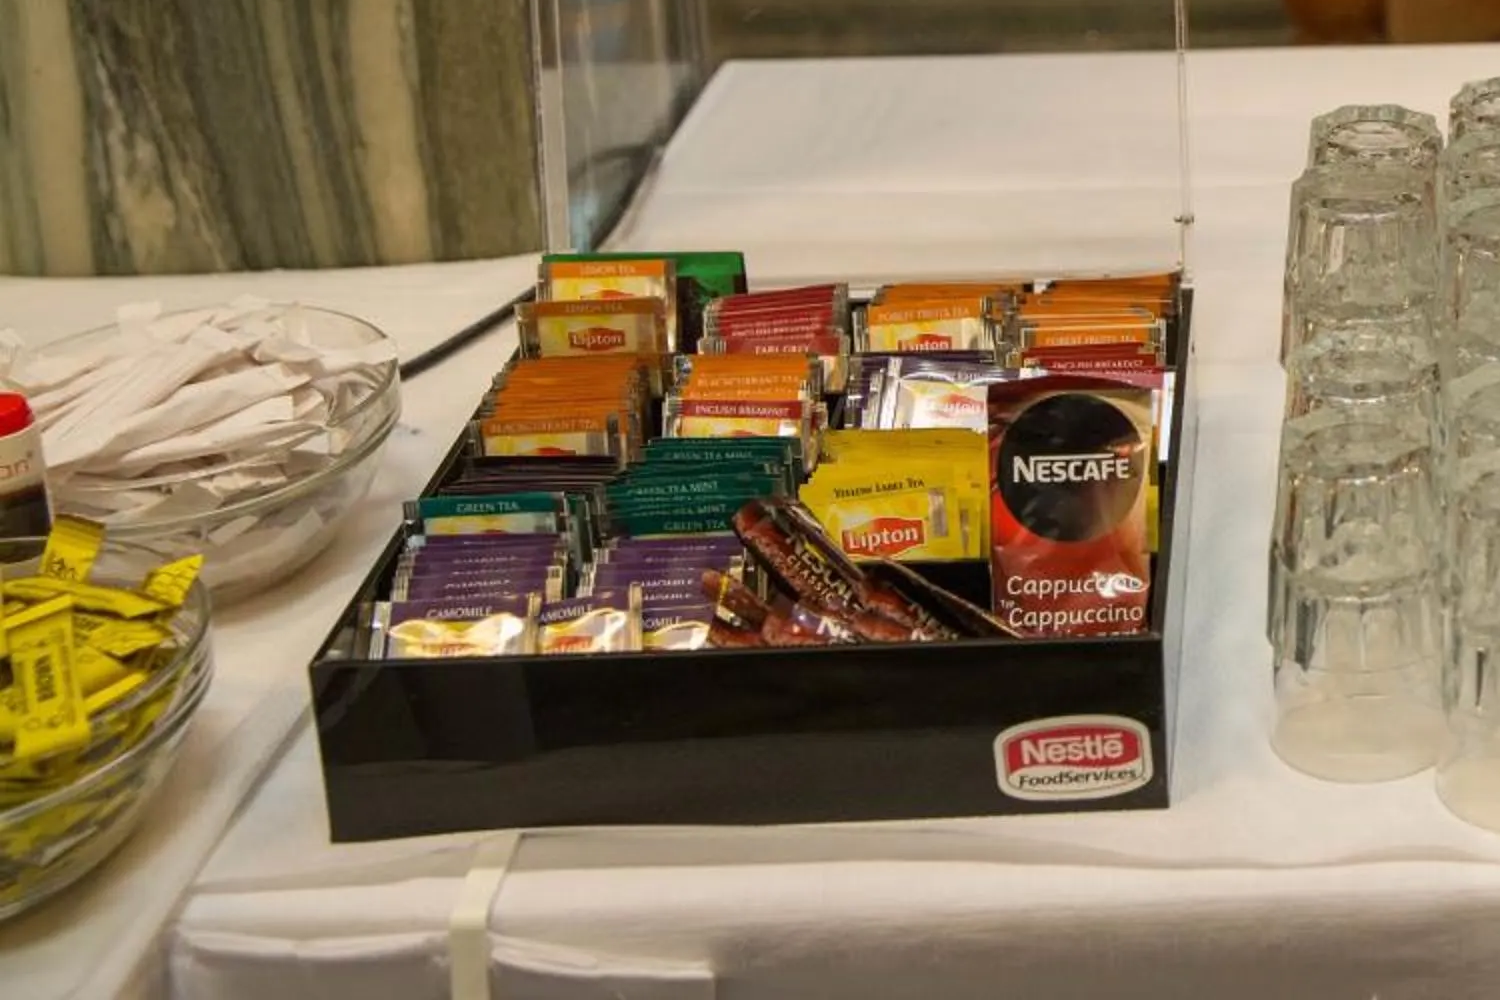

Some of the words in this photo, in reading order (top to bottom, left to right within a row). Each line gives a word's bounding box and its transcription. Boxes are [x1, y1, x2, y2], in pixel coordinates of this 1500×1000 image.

[572, 332, 622, 348] Lipton
[834, 486, 872, 498] YELLOW
[875, 481, 903, 493] LABEL
[906, 476, 925, 489] TEA
[456, 503, 496, 514] GREEN
[499, 501, 520, 512] TEA
[848, 525, 919, 551] Lipton
[426, 605, 494, 619] CAMOMILE
[540, 603, 594, 622] AMOMILE
[1008, 604, 1144, 632] Cappuccino
[642, 615, 683, 629] OMILE
[1018, 769, 1138, 789] FoodServices
